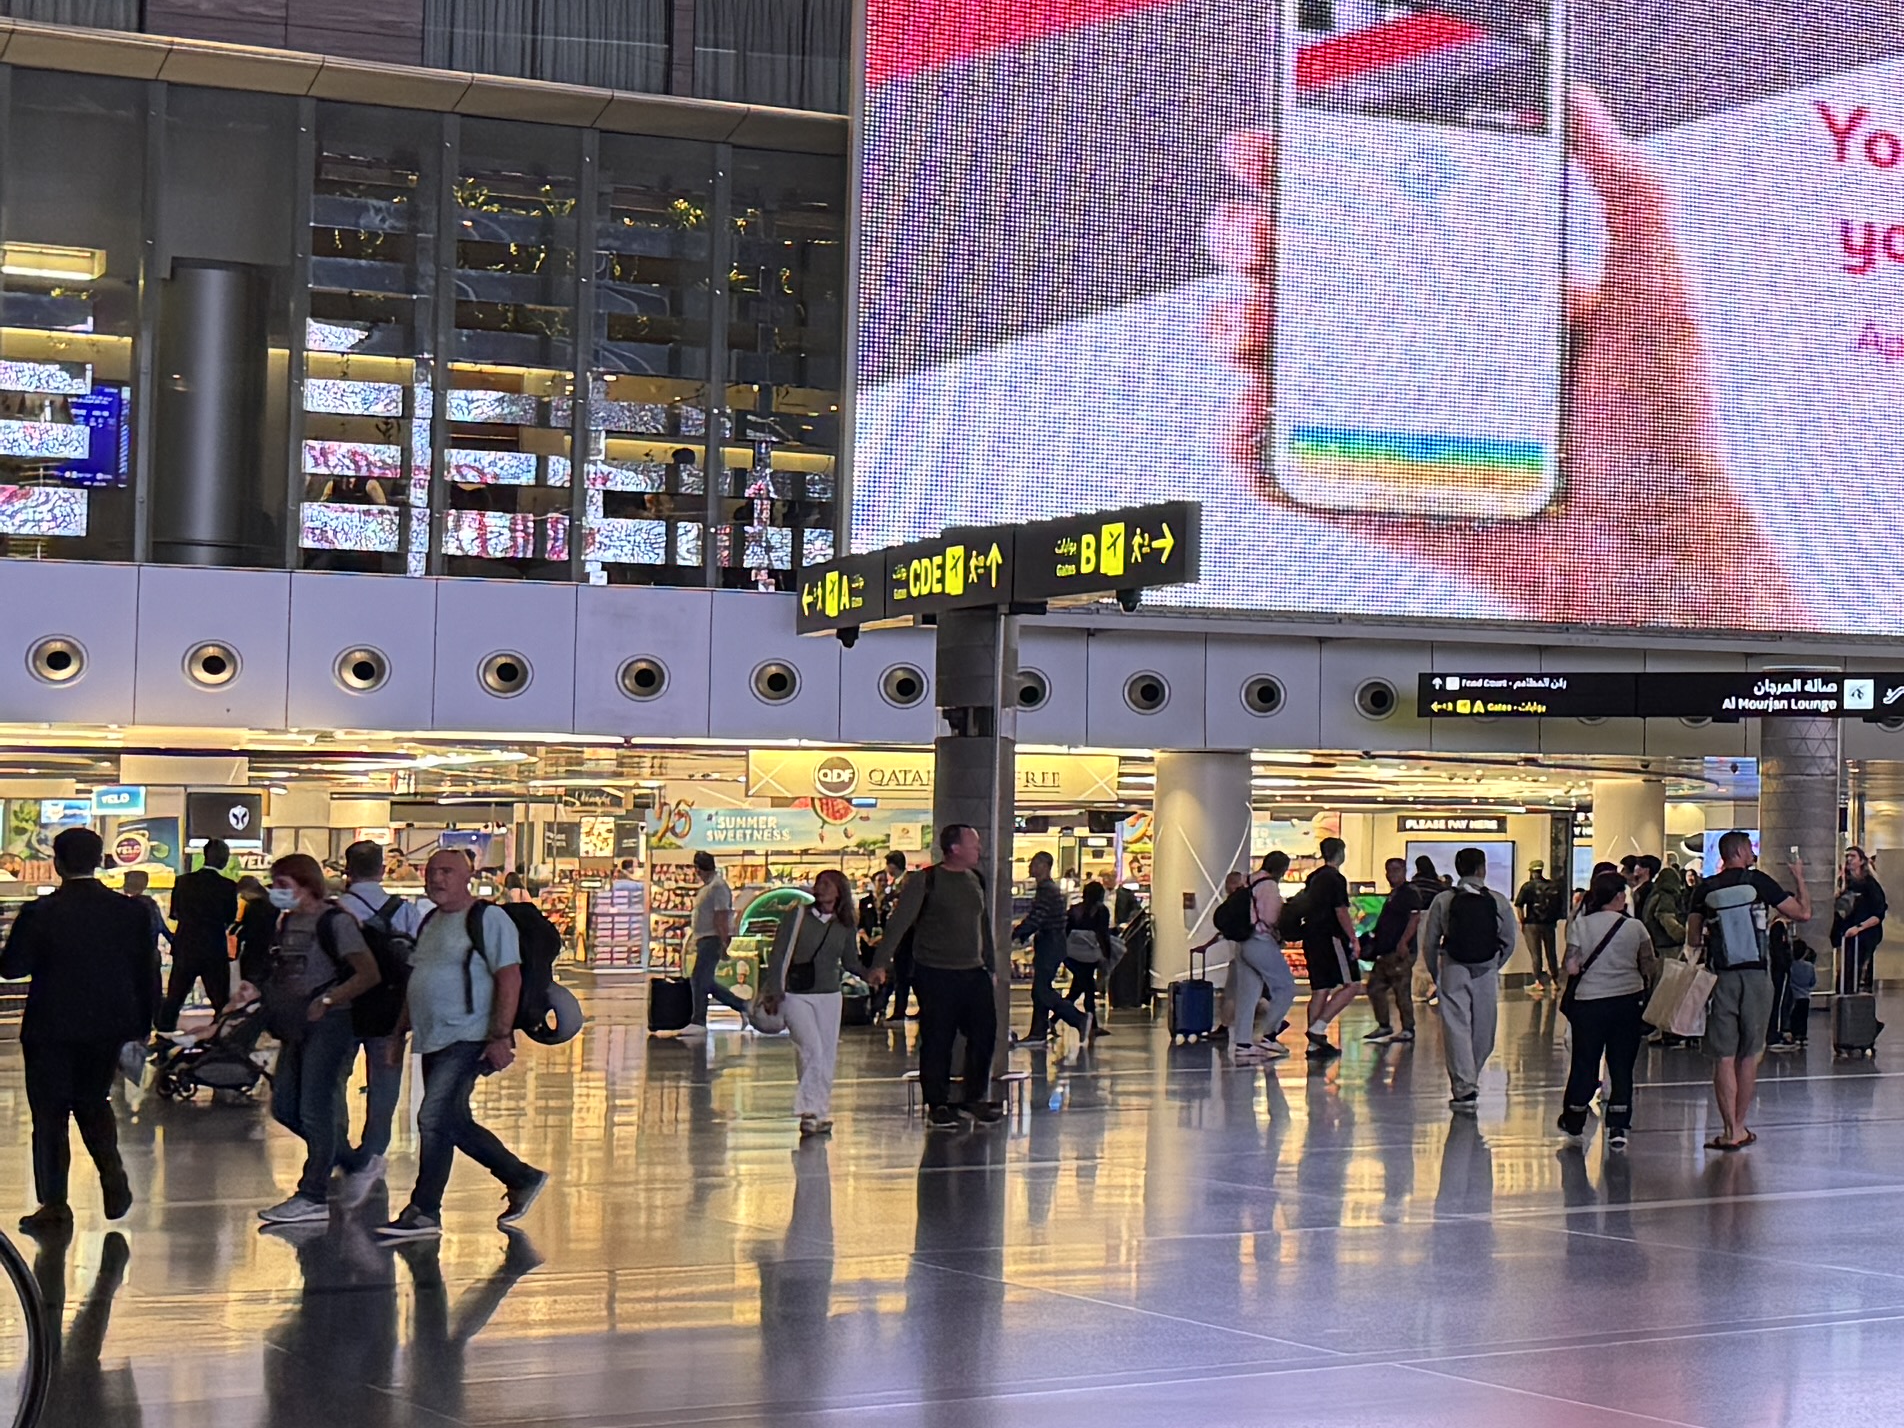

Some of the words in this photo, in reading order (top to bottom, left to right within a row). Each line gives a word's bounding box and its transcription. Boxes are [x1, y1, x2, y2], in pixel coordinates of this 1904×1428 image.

[1081, 534, 1096, 574] B
[909, 556, 943, 597] CDE
[840, 575, 850, 610] A
[1753, 678, 1801, 696] المرجان
[1804, 678, 1838, 694] صالة
[1472, 700, 1485, 713] A
[1722, 696, 1736, 710] Al
[1738, 697, 1788, 712] Mourjan
[1791, 697, 1838, 712] Lounge
[817, 768, 854, 784] QDF
[101, 793, 130, 804] VELO
[717, 815, 777, 829] SUMMER
[1405, 819, 1446, 830] PLEASE
[1447, 819, 1469, 830] PAY
[706, 828, 792, 842] SWEETNESS
